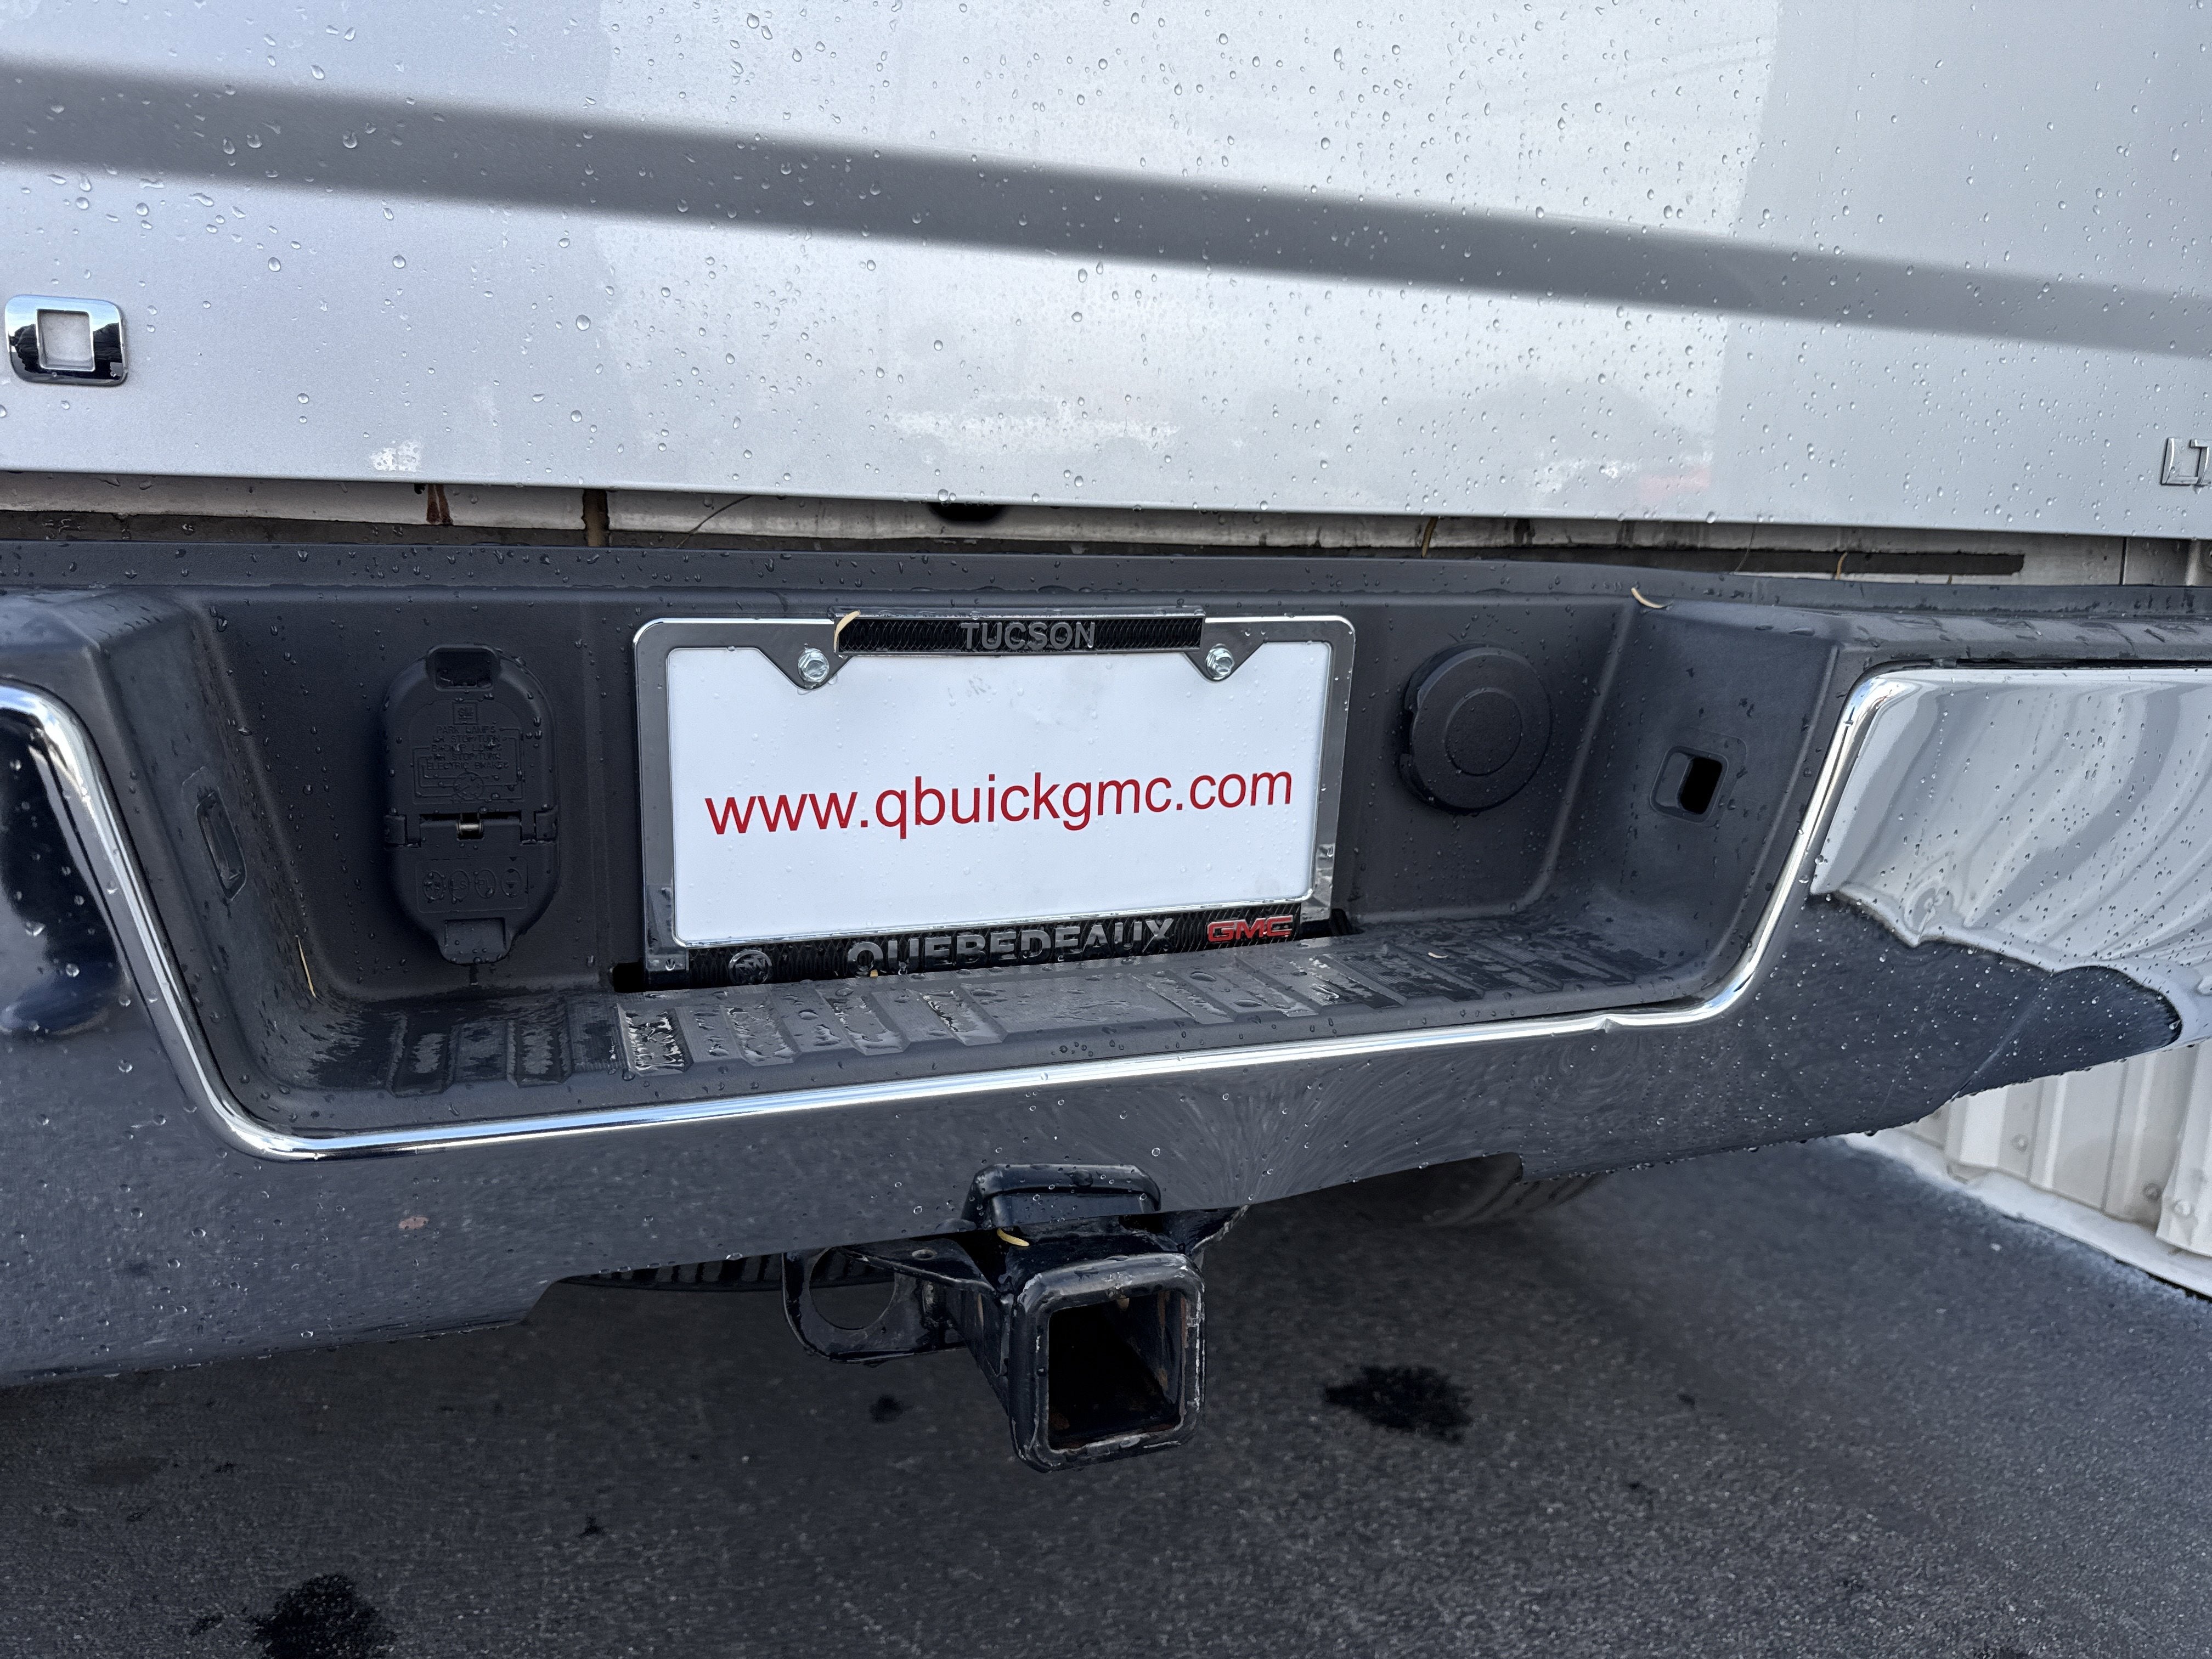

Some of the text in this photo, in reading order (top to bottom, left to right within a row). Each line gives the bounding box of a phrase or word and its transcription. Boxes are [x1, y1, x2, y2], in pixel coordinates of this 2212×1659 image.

[961, 621, 1096, 650] TUCSON
[436, 725, 459, 733] PARK
[705, 772, 1291, 838] www.qbuickgmc.com
[1207, 915, 1293, 942] GMC
